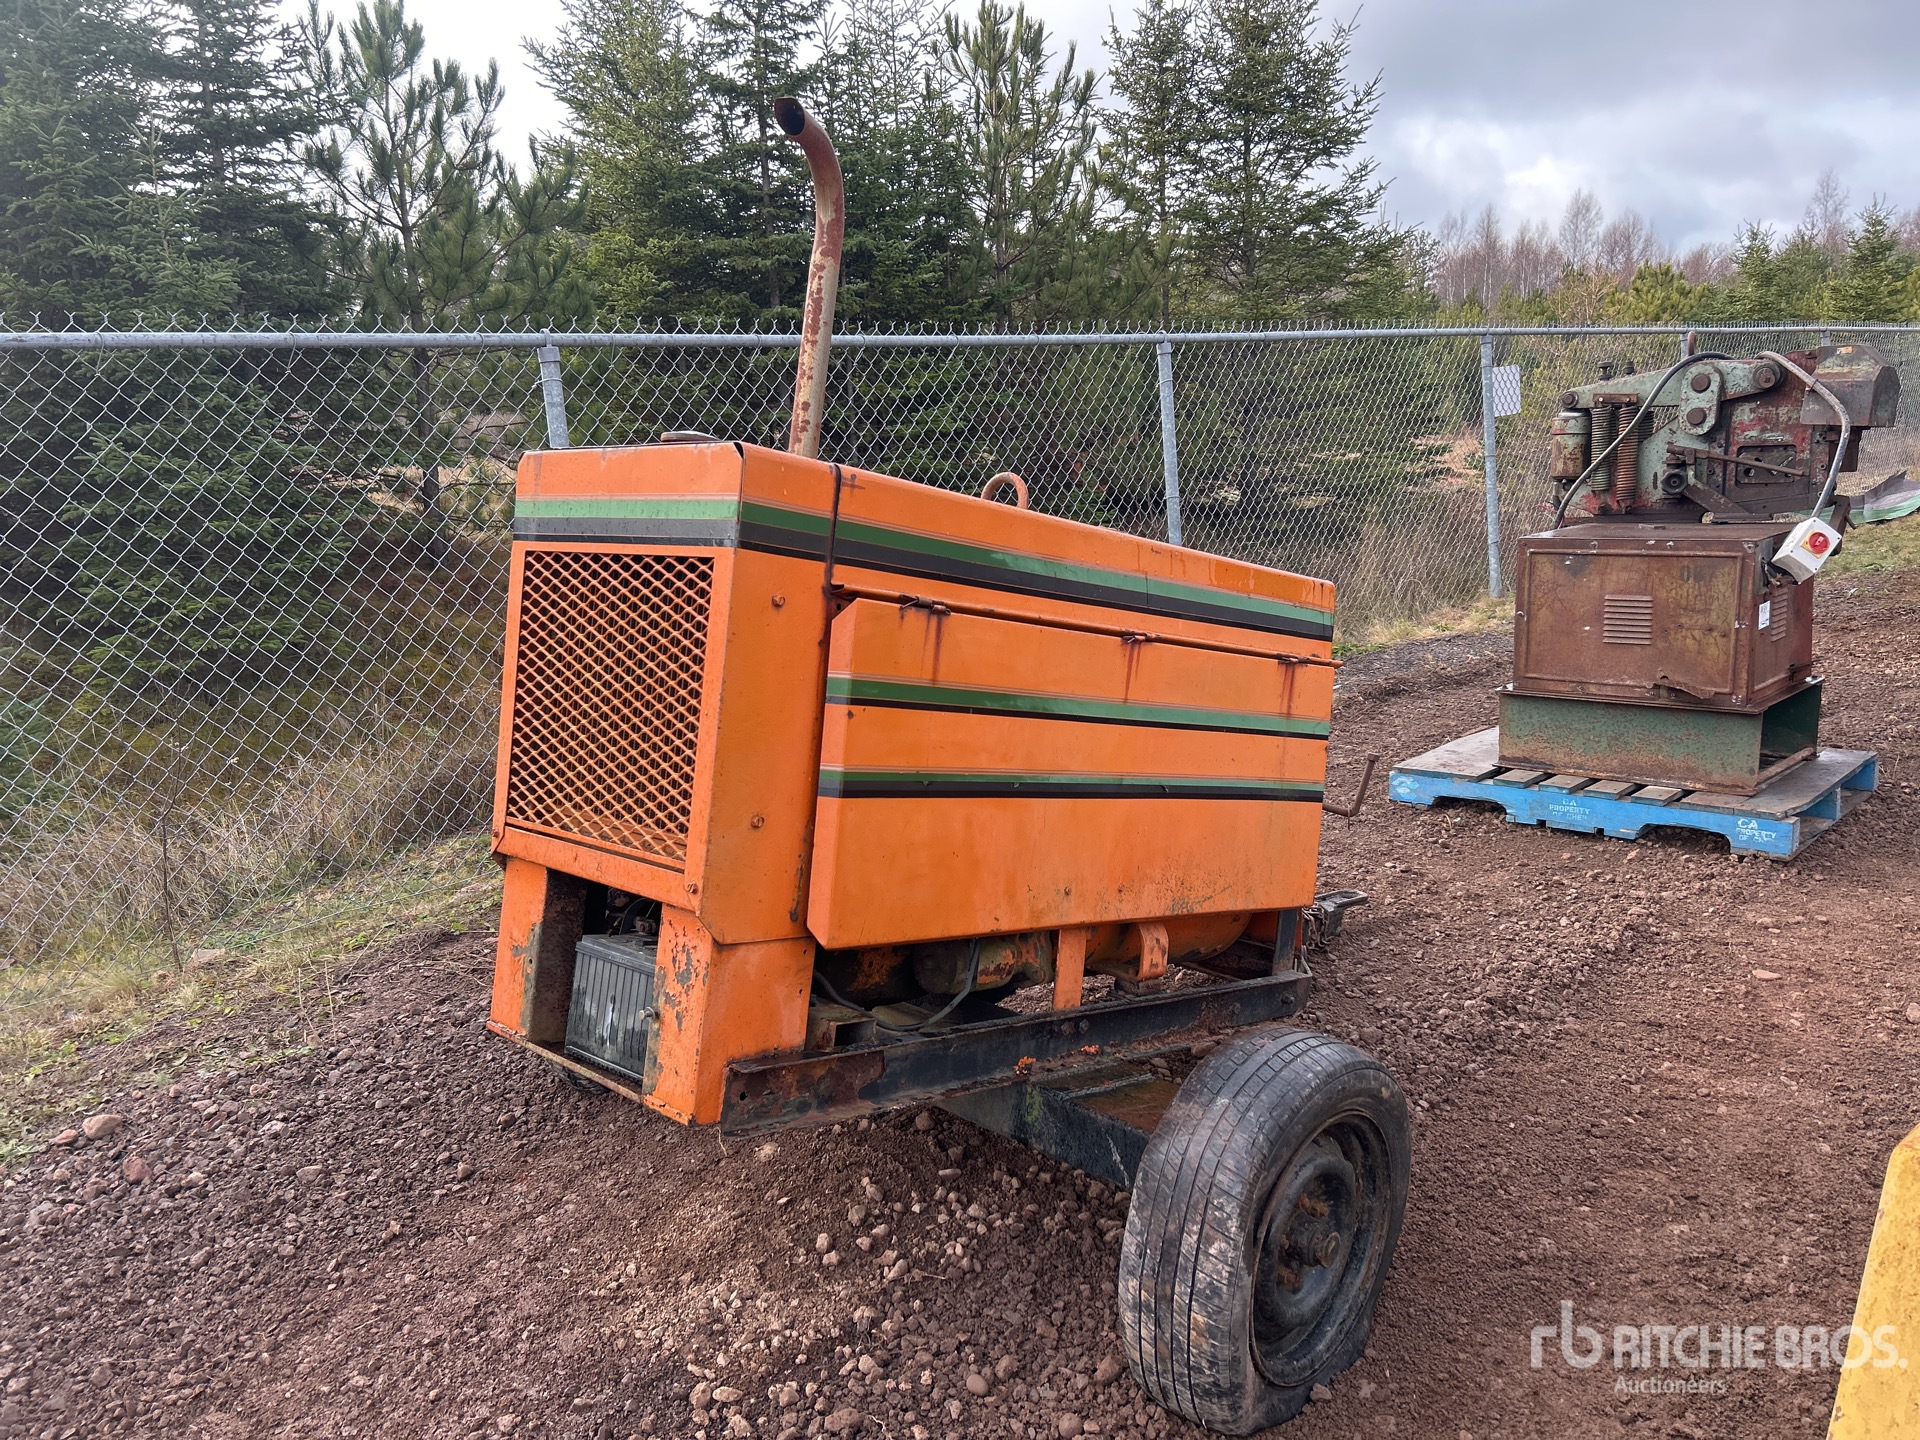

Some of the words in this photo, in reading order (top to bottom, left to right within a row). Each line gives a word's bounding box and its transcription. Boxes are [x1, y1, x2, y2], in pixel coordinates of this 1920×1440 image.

[1562, 798, 1577, 806] CA
[1549, 804, 1591, 815] PROPERTY
[1737, 818, 1758, 830] CA
[1735, 827, 1777, 840] PROPERTY
